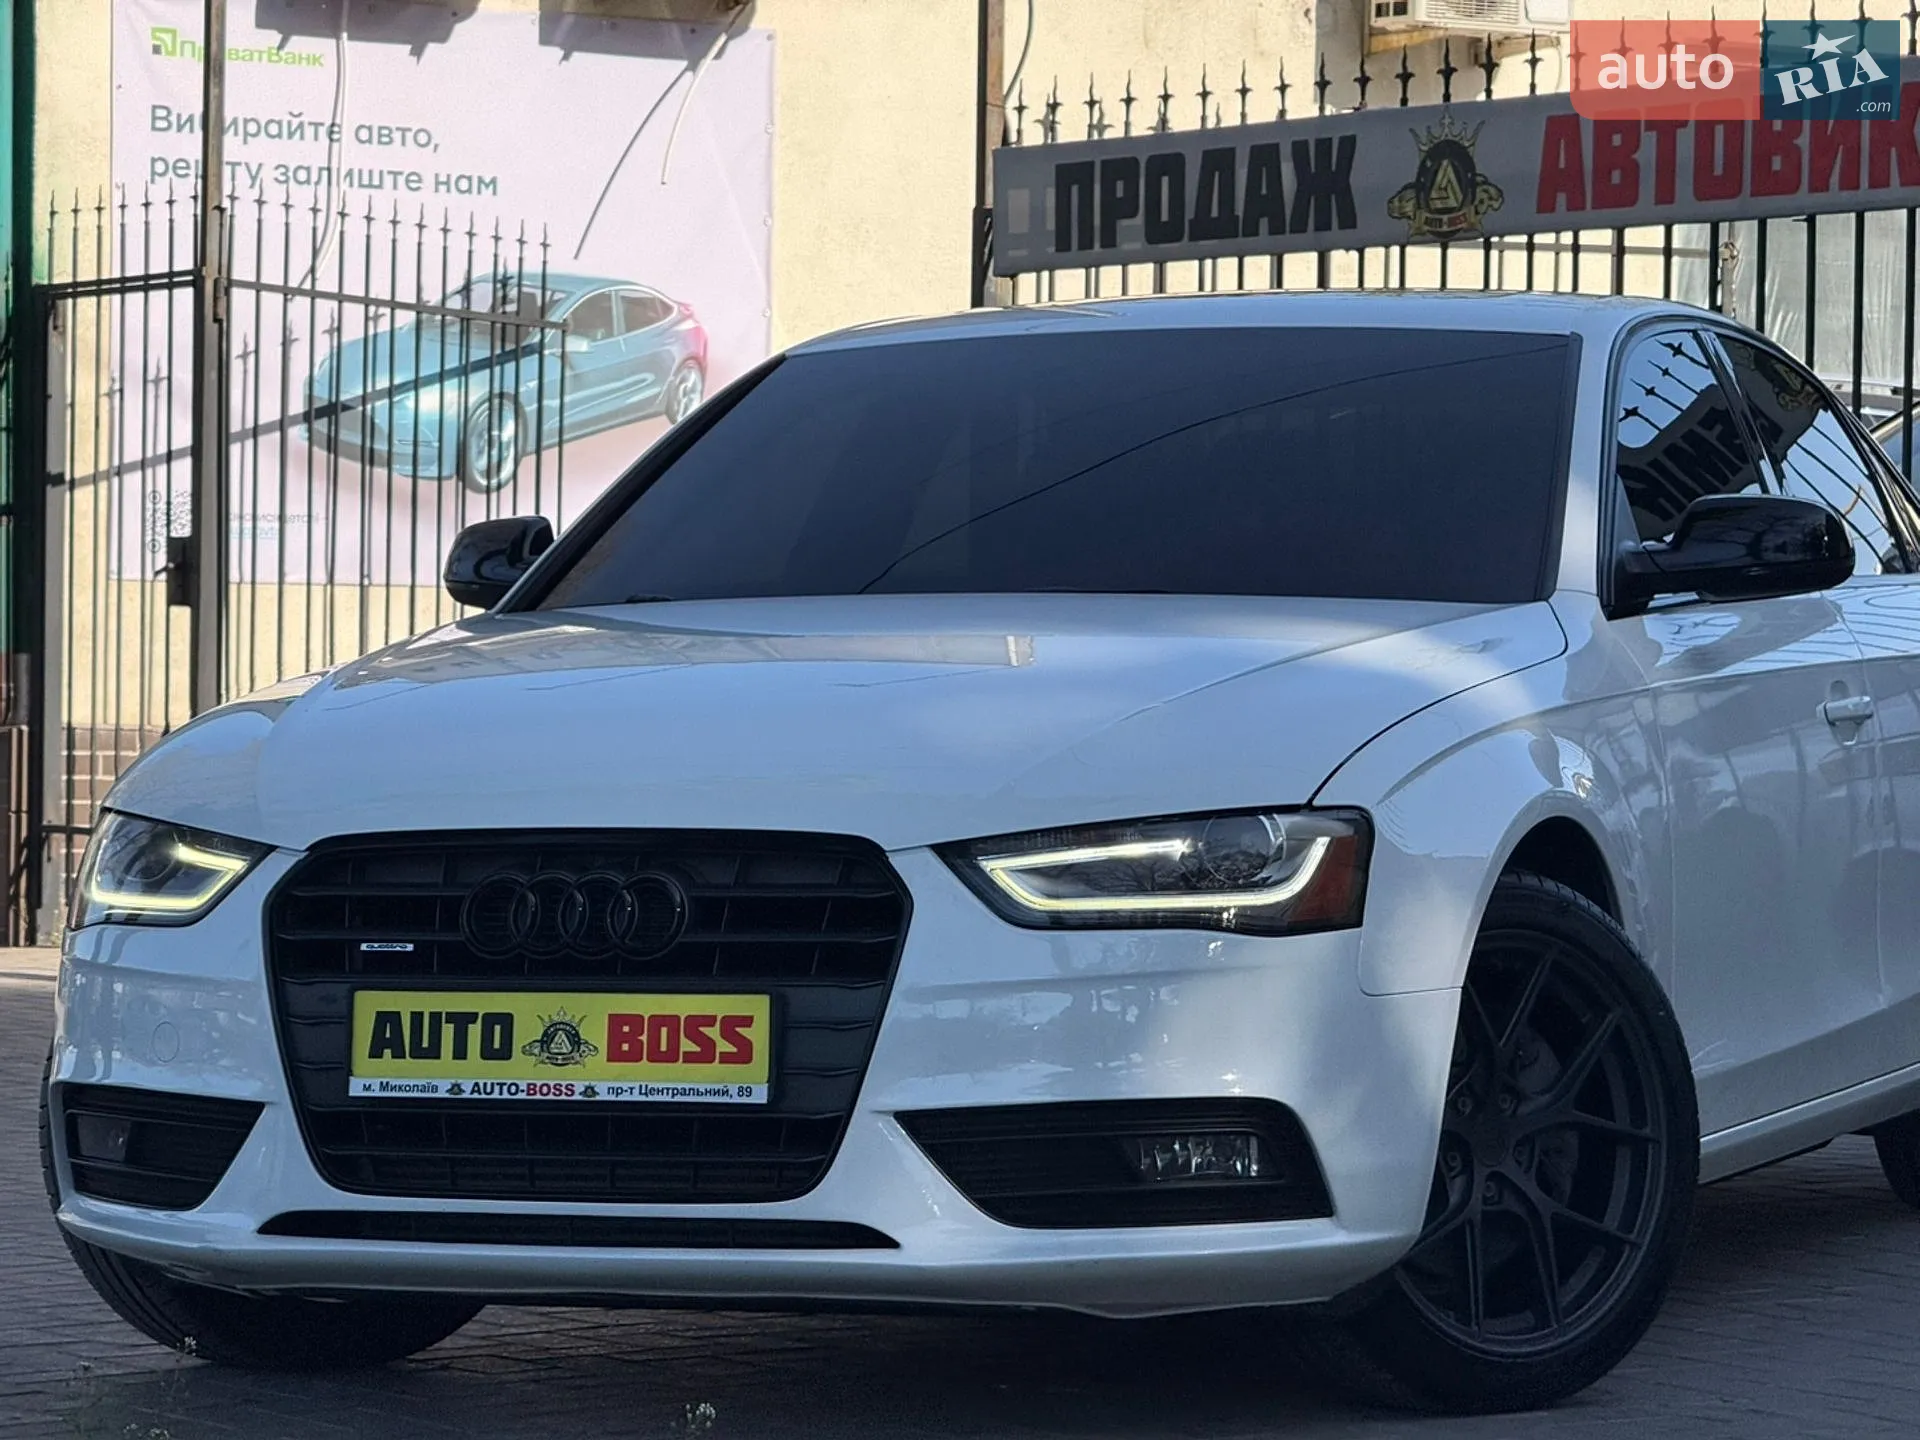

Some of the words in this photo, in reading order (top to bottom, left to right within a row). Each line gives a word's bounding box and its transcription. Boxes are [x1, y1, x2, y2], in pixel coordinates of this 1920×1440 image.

[180, 40, 324, 67] ПватБанк
[150, 104, 342, 145] Виирайте
[355, 122, 440, 153] авто,
[434, 171, 498, 196] нам
[1055, 134, 1358, 253] ПРОДАЖ
[368, 1010, 514, 1061] AUTO
[606, 1013, 755, 1065] BOSS
[362, 1083, 376, 1093] м.
[379, 1080, 439, 1094] Миколаїв
[470, 1081, 576, 1097] AUTO-BOSS
[607, 1085, 636, 1098] пр-т
[638, 1084, 734, 1099] Центральний,
[737, 1085, 752, 1098] 89
